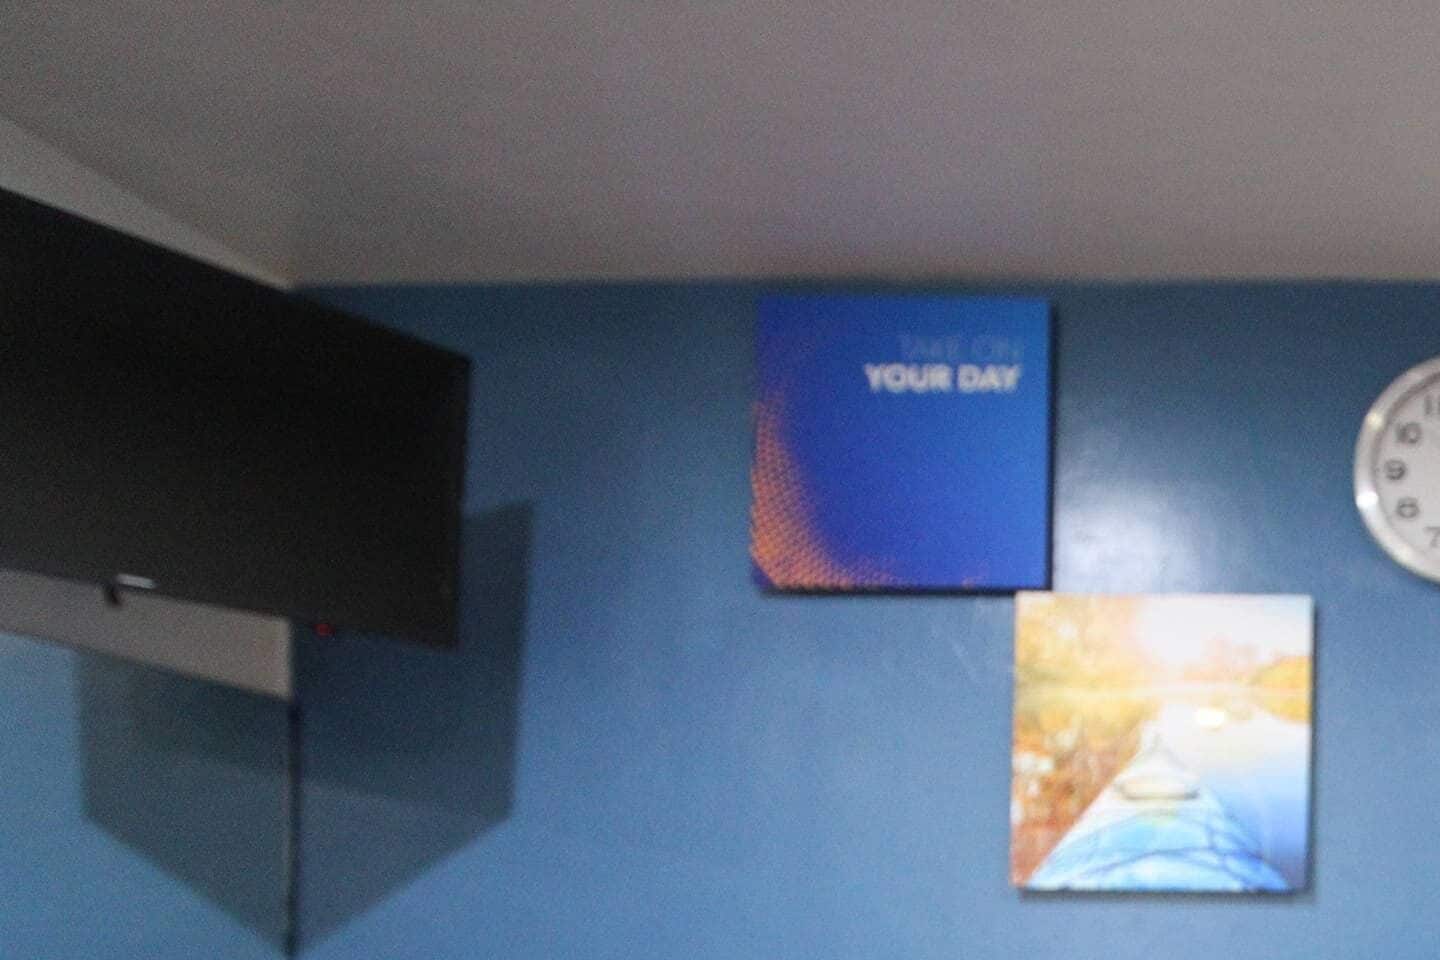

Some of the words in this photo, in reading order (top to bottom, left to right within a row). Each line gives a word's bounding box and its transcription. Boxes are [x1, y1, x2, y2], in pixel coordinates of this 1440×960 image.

[864, 363, 952, 393] YOUR
[956, 363, 1020, 393] DAY
[1384, 459, 1408, 482] 9
